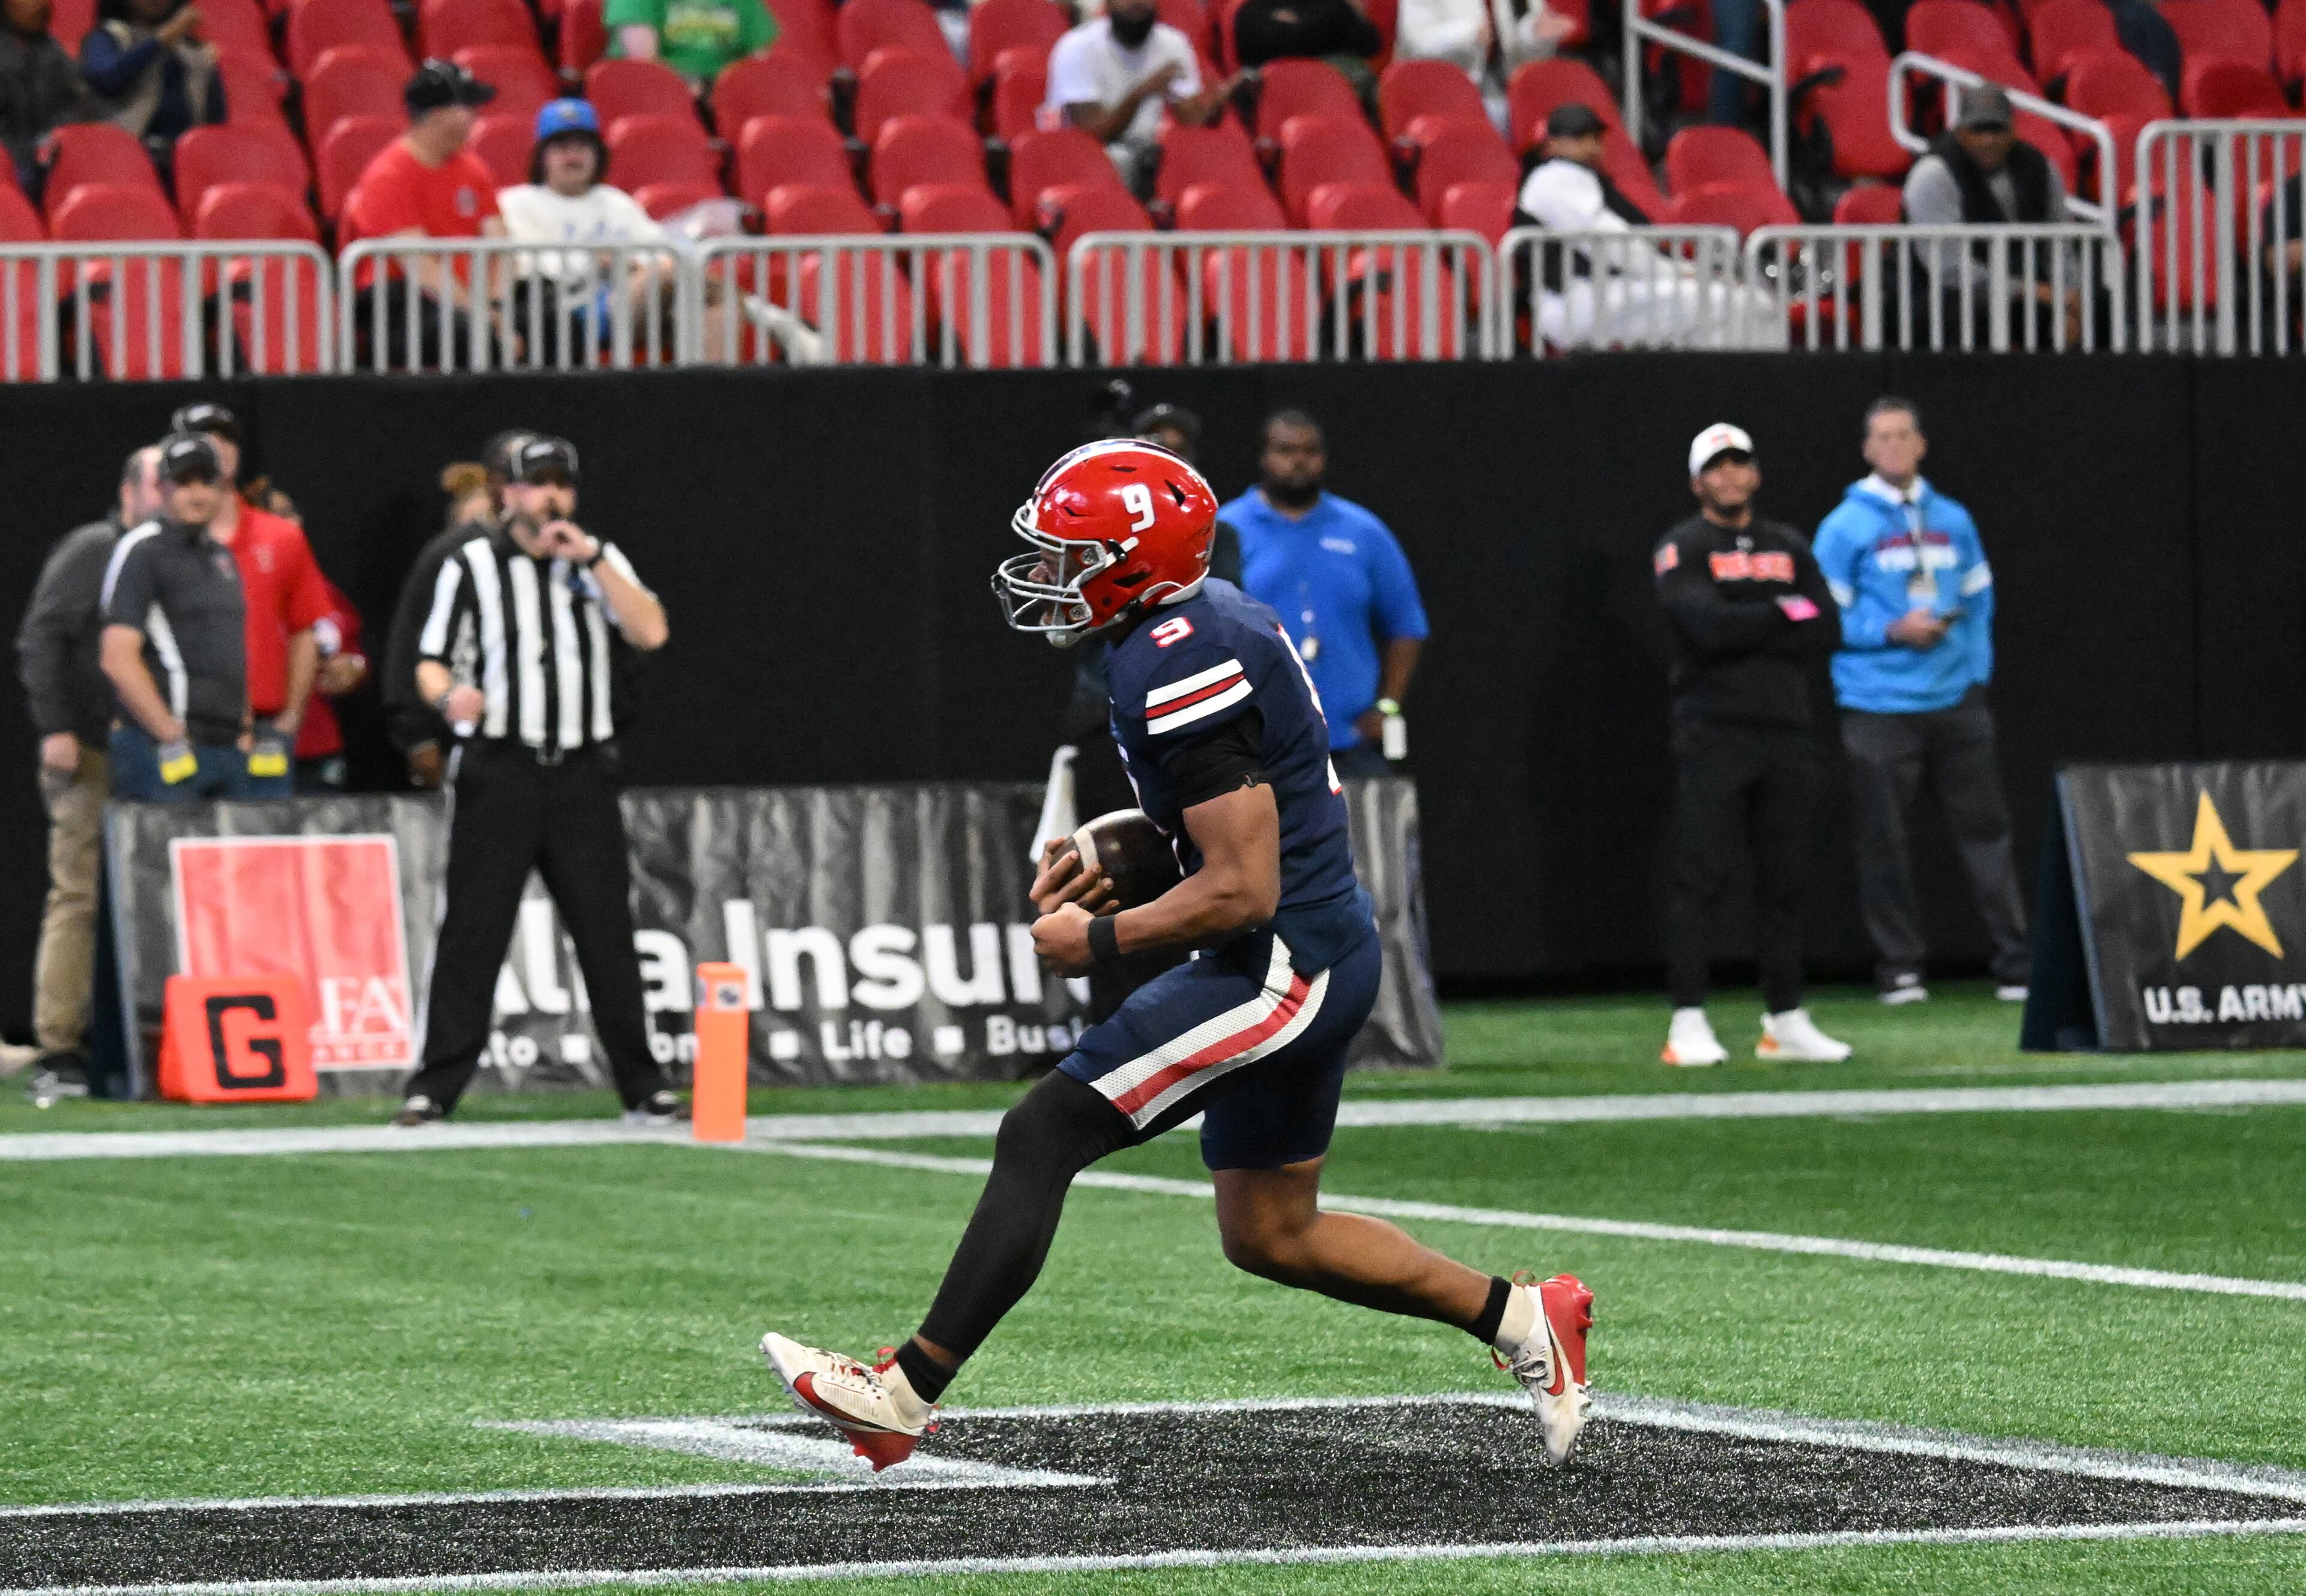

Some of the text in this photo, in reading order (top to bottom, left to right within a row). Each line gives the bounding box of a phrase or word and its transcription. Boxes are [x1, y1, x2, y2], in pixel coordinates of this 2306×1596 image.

[1121, 482, 1155, 533] 9
[1149, 615, 1194, 648] 9
[318, 976, 410, 1036] FA
[2143, 985, 2214, 1023] U.S.
[206, 994, 286, 1089] G
[820, 1019, 912, 1060] Life
